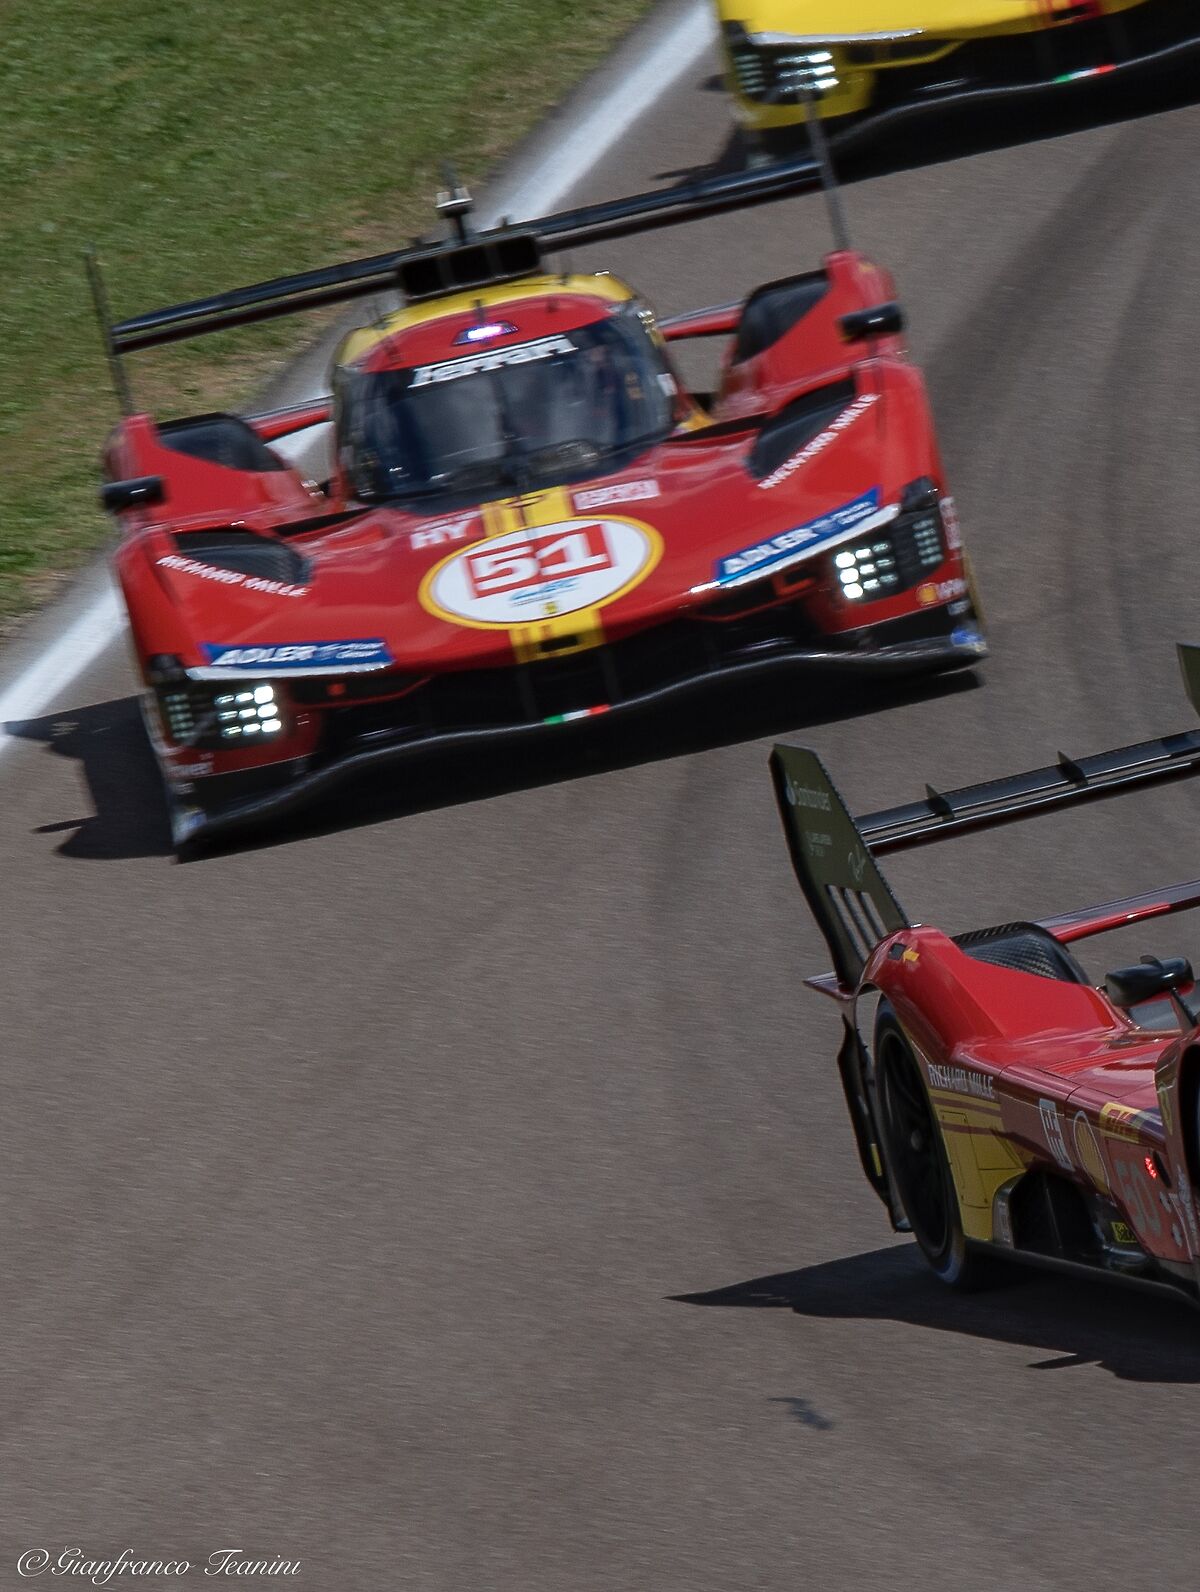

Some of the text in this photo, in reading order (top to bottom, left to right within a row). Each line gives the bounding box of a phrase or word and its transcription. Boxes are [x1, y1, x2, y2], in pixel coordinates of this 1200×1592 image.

[410, 518, 473, 550] HY
[721, 527, 819, 575] ADLER
[156, 554, 247, 585] RICHARD
[470, 533, 609, 592] 51
[210, 645, 318, 666] ADLER
[928, 1063, 996, 1099] RICHARD MILLE
